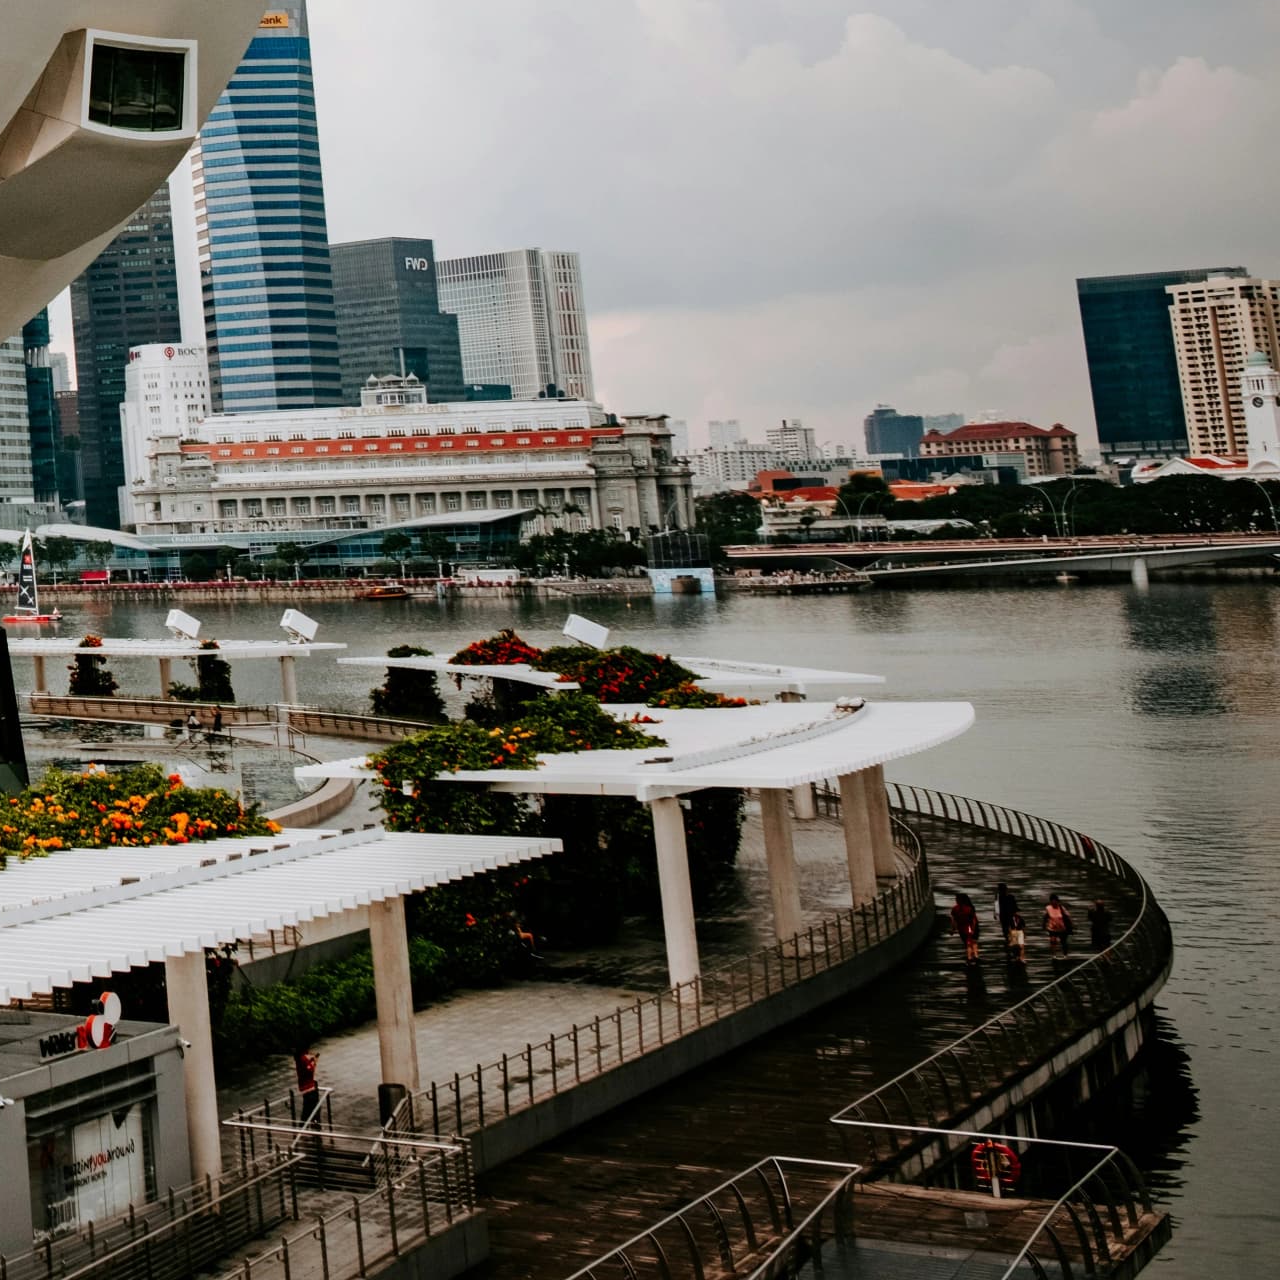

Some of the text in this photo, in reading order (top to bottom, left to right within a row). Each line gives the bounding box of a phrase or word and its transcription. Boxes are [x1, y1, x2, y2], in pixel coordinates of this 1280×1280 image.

[404, 256, 429, 271] FWD
[177, 347, 198, 357] BOC
[361, 405, 415, 416] FULLON
